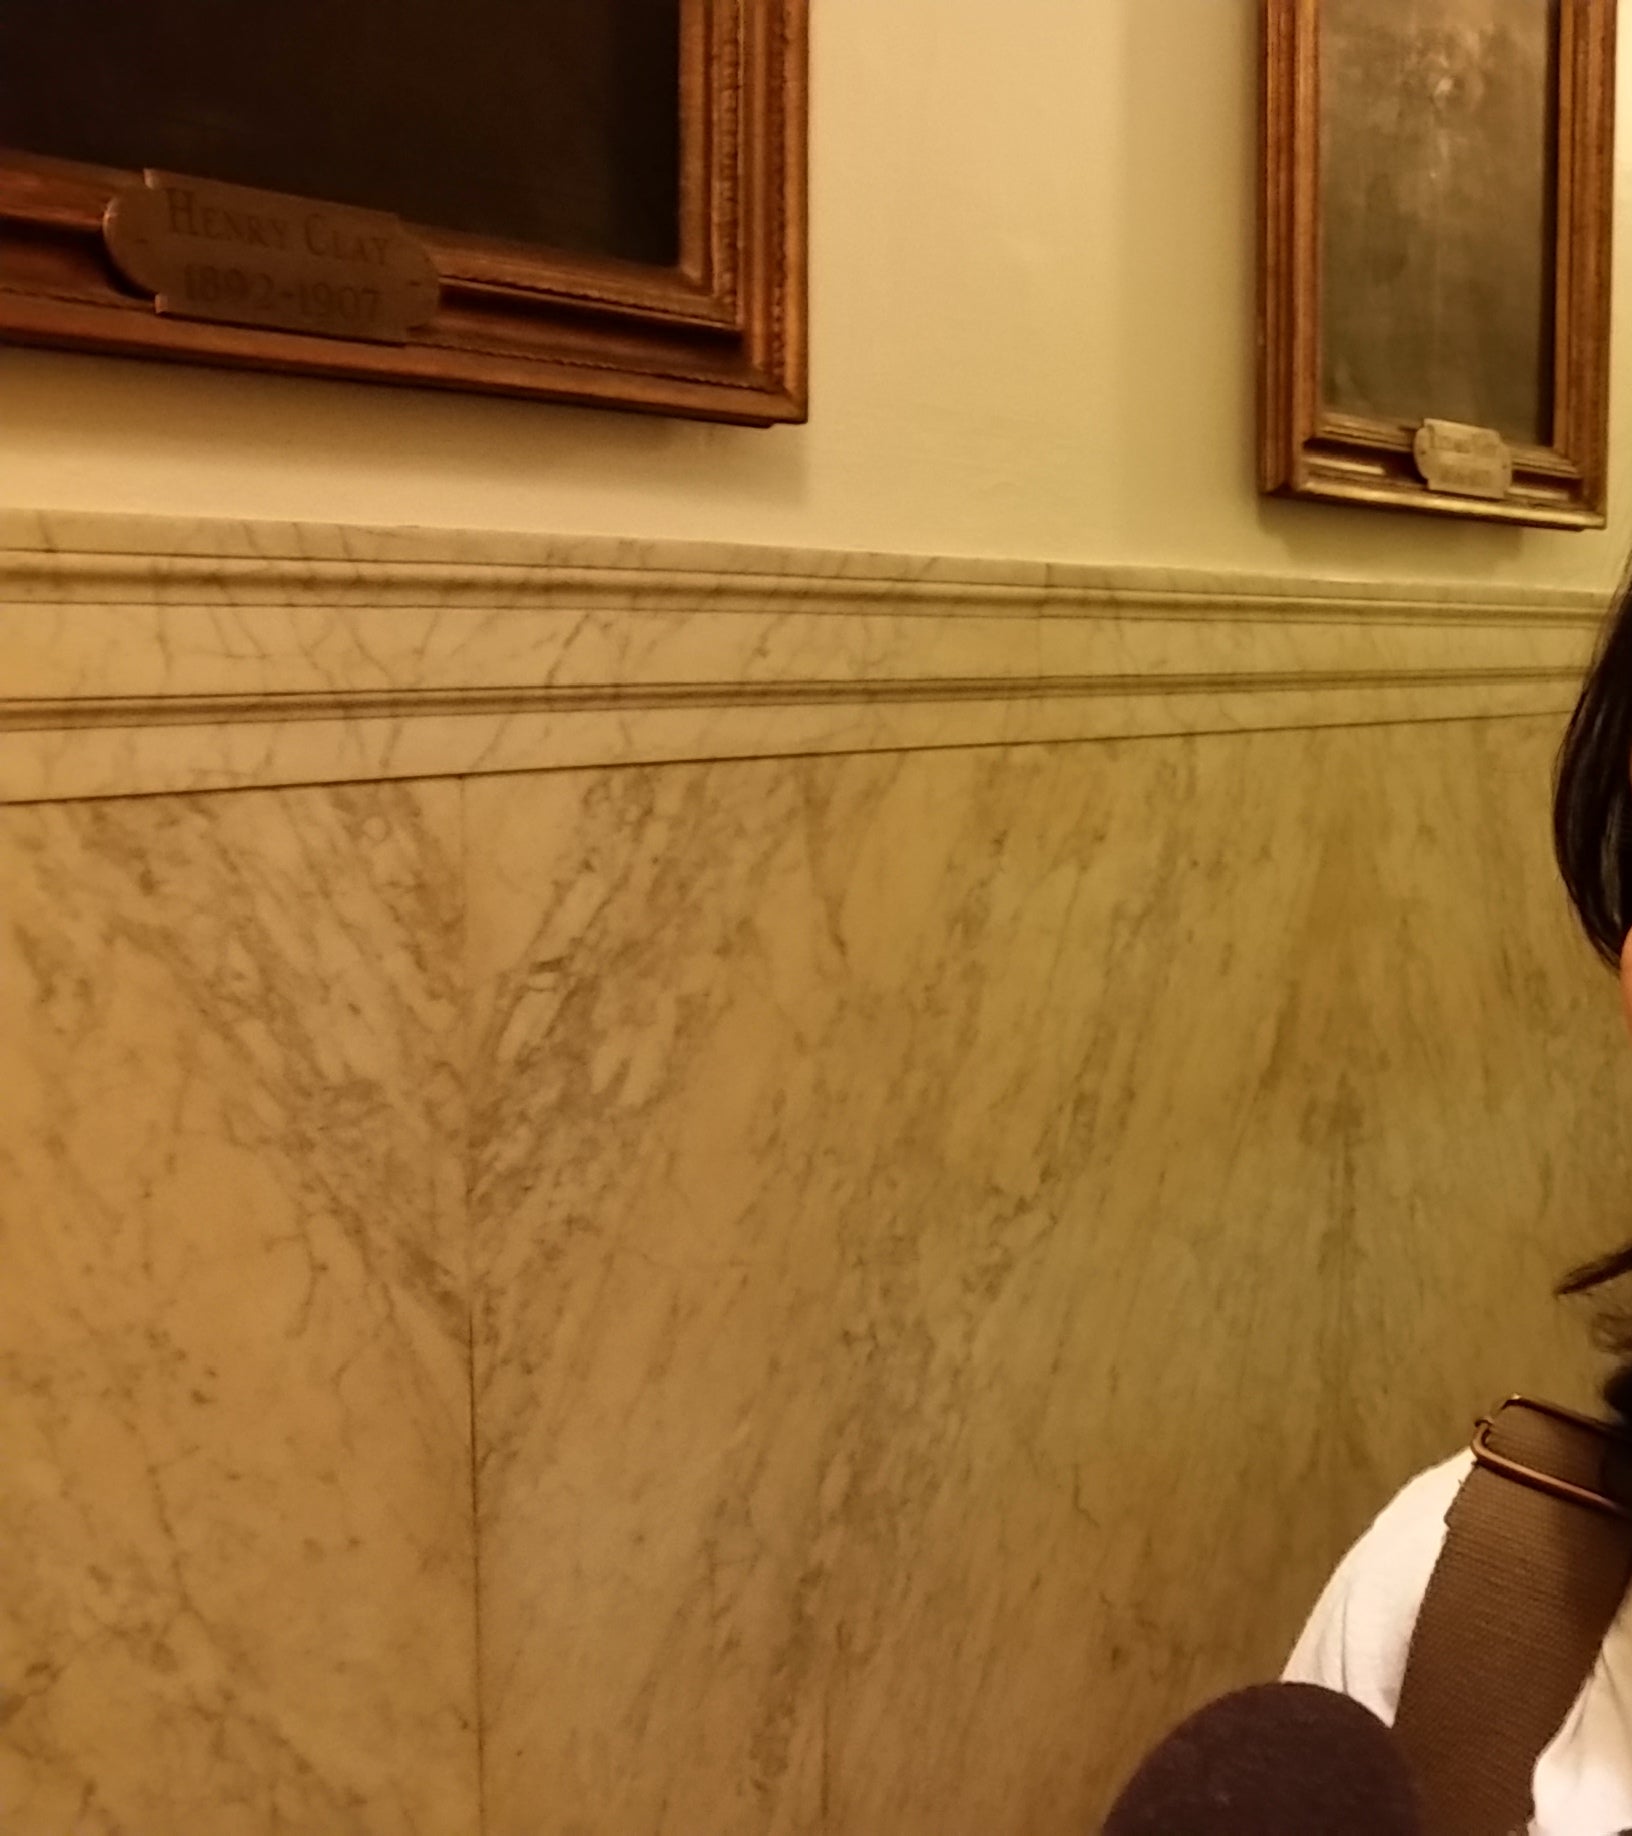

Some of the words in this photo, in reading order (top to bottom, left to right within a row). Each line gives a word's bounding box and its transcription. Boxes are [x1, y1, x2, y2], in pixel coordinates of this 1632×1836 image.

[166, 187, 287, 249] HENRY
[304, 213, 389, 266] CLAY
[184, 264, 380, 319] 1892-1907
